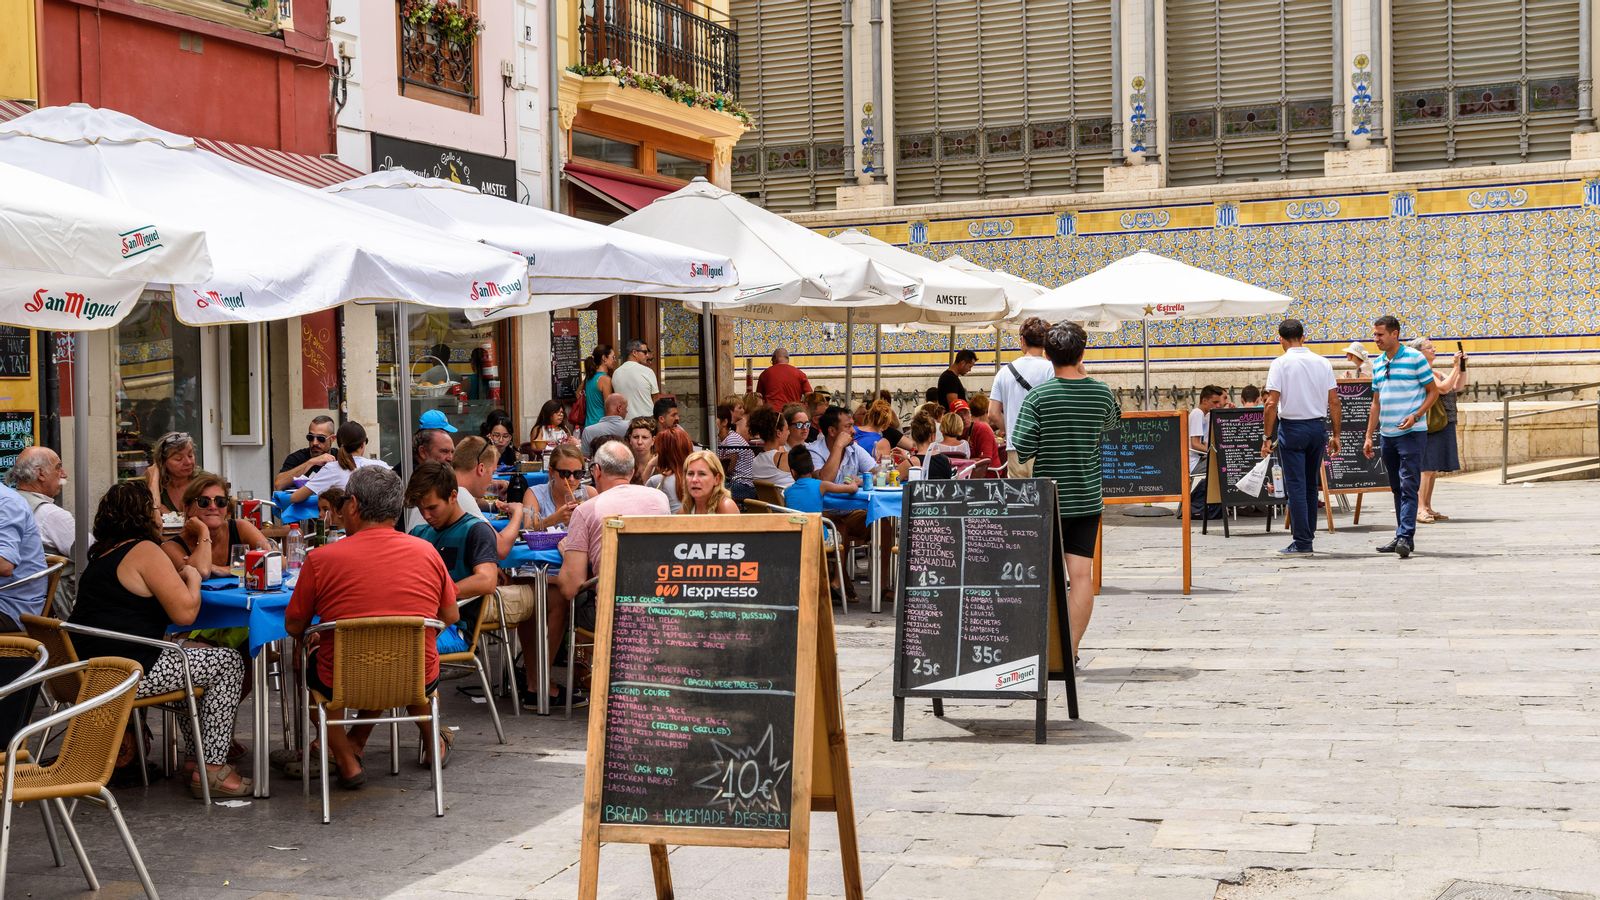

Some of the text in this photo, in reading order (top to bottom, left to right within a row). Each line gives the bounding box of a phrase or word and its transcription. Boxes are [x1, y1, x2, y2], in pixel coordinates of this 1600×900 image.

[481, 181, 507, 197] AMSTEL
[936, 294, 967, 306] AMSTEL
[1156, 304, 1184, 312] Estrella
[0, 420, 31, 434] AMBAS
[1120, 432, 1161, 442] MOMENTO
[913, 480, 1040, 505] MIX DE TAPAS
[1129, 483, 1134, 493] 2
[912, 506, 947, 515] COMBO 1
[1001, 507, 1008, 515] 2
[912, 534, 955, 544] BOQUERONES
[674, 542, 745, 560] CAFES
[912, 542, 942, 550] FRITOS
[911, 549, 954, 558] MEJILLONES
[910, 557, 957, 568] ENSALADILLA
[657, 562, 738, 581] gamma
[640, 596, 665, 604] COURSE
[620, 606, 645, 614] SALADS
[908, 609, 943, 617] BOQUERONES
[969, 634, 1009, 642] LANGOSTINOS
[703, 641, 726, 650] SAUCE
[615, 662, 701, 677] GRILLED VEGETABLES
[661, 675, 680, 684] EGGS
[612, 687, 671, 697] SECOND COURSE
[613, 702, 647, 711] MEATBALLS
[666, 706, 687, 715] SAUCE
[706, 717, 728, 726] SAUCE
[632, 728, 653, 736] FRIED
[656, 731, 692, 740] CALAMARI
[608, 762, 673, 776] FISH (ASK FOR)
[608, 773, 677, 785] CHICKEN BREAST
[608, 784, 647, 795] LASSAGNA
[605, 805, 648, 822] BREAD
[665, 809, 726, 825] HOMEMADE
[734, 810, 788, 827] DESSERT
